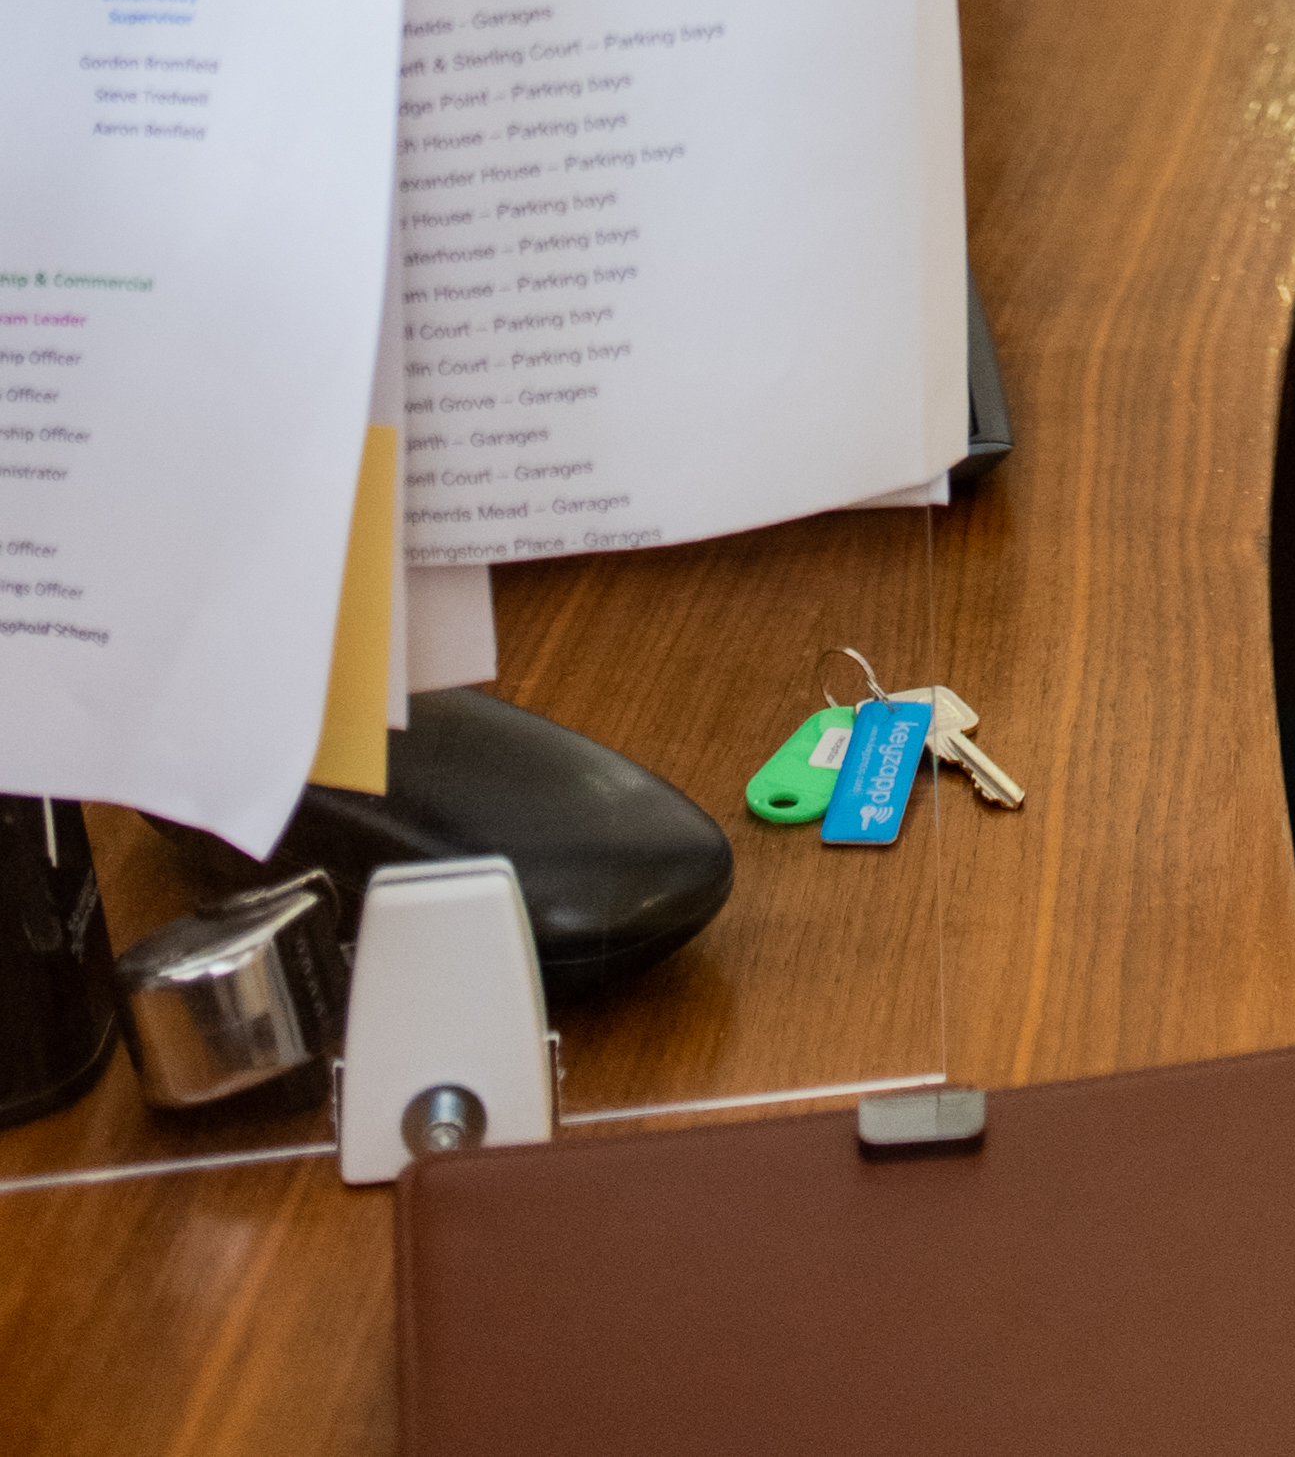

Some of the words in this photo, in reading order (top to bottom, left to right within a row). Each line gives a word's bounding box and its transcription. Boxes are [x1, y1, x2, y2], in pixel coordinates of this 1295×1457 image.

[403, 19, 454, 38] fields
[470, 5, 554, 30] Garages
[79, 55, 139, 70] Gordon
[452, 48, 524, 71] Sterling
[529, 38, 581, 60] Court
[603, 28, 676, 53] Parking
[94, 89, 138, 103] Steve
[399, 98, 433, 119] dge
[440, 90, 489, 111] Point
[510, 80, 583, 103] Parking
[92, 122, 139, 137] Aaron
[423, 130, 483, 152] House
[506, 120, 579, 144] Parking
[400, 171, 475, 192] exander
[481, 164, 542, 185] House
[564, 151, 637, 175] Parking
[412, 210, 473, 230] House
[496, 199, 568, 221] Parking
[403, 245, 496, 267] aterhouse
[518, 234, 591, 257] Parking
[0, 272, 28, 289] hip
[53, 273, 154, 292] Commercial
[434, 281, 495, 302] House
[516, 272, 589, 295] Parking
[34, 313, 88, 327] Leader
[419, 320, 471, 341] Court
[493, 312, 565, 335] Parking
[0, 351, 25, 365] hip
[29, 349, 83, 366] Officer
[438, 355, 489, 376] Court
[511, 349, 583, 372] Parking
[6, 387, 60, 403] Officer
[439, 394, 496, 414] Grove
[518, 383, 600, 406] Garages
[0, 428, 34, 442] ship
[39, 428, 92, 444] Officer
[469, 427, 551, 450] Garages
[0, 465, 68, 481] nistrator
[405, 470, 436, 488] sell
[441, 467, 494, 487] Court
[513, 459, 595, 482] Garages
[404, 507, 472, 526] pherds
[477, 501, 529, 522] Mead
[551, 492, 632, 516] Garages
[7, 541, 58, 558] Officer
[404, 541, 508, 563] ppingstone
[513, 535, 565, 556] Place
[583, 524, 664, 549] Garages
[0, 580, 32, 597] ings
[35, 581, 85, 599] Officer
[0, 621, 51, 636] sehold
[54, 623, 111, 646] Scheme
[866, 720, 920, 804] keyzapp
